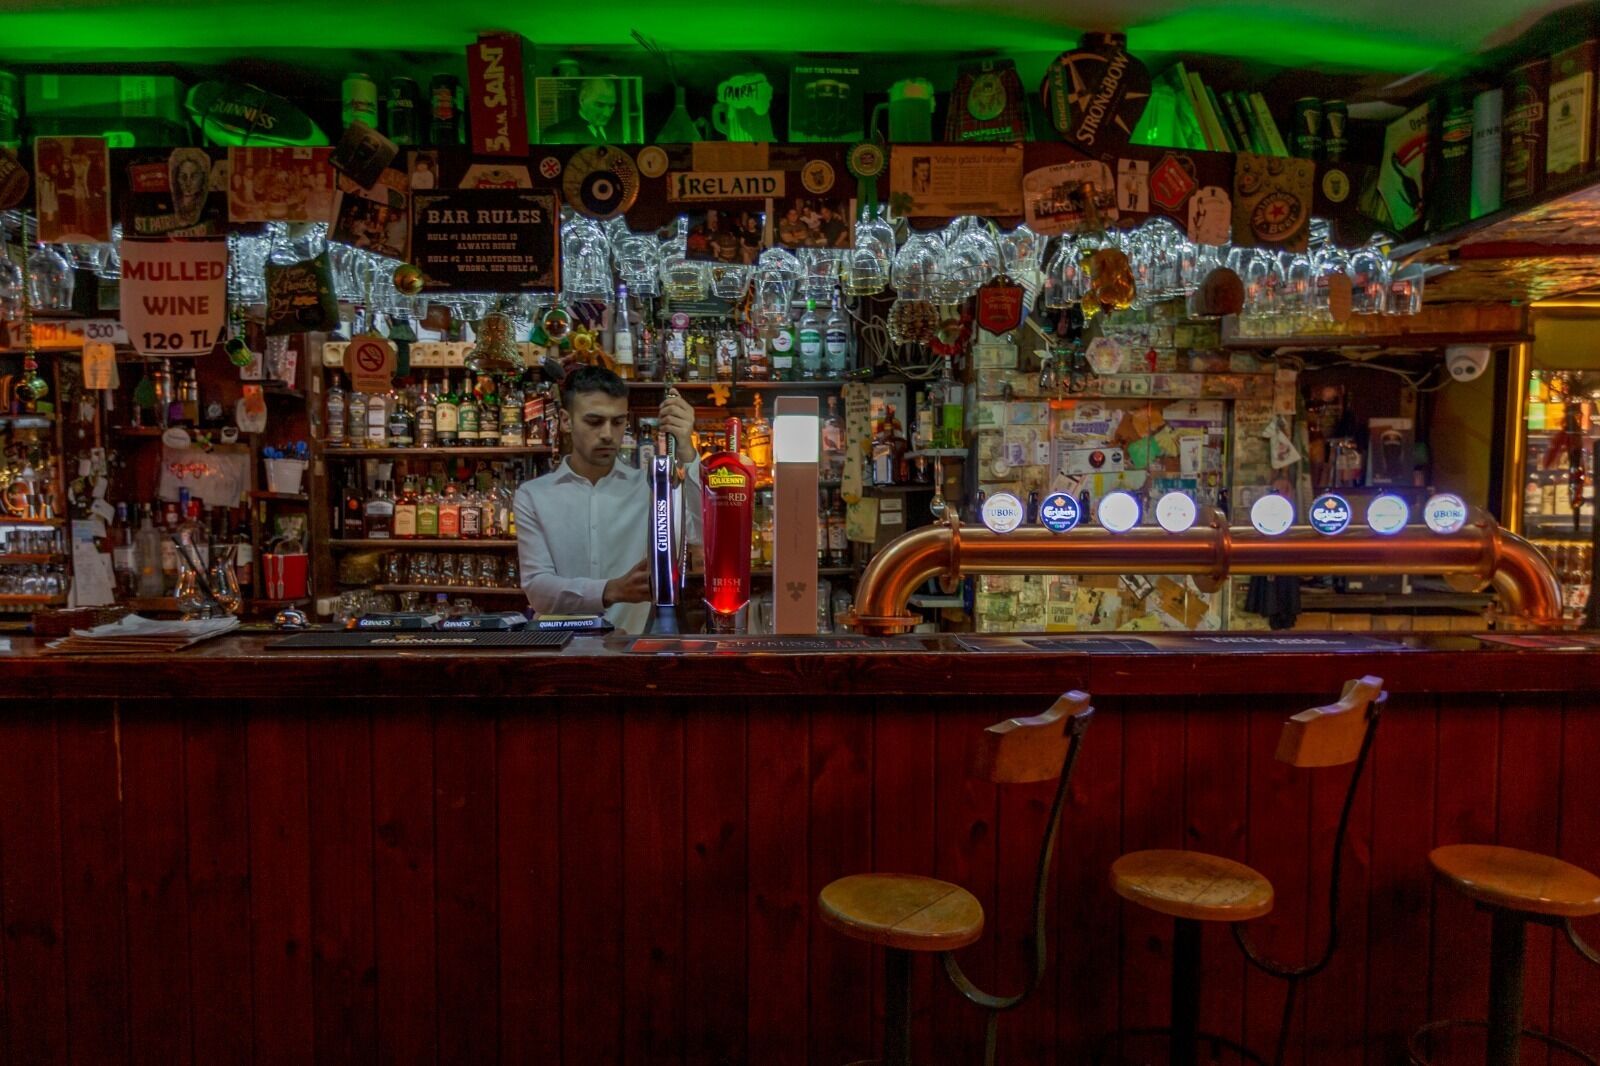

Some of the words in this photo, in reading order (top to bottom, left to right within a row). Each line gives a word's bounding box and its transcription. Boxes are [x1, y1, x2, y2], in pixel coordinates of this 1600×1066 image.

[480, 43, 508, 108] SAINT
[723, 80, 764, 101] MURAT
[1076, 49, 1129, 146] STRONGBOW
[677, 174, 777, 196] IRELAND
[1037, 194, 1115, 216] MAGNRS
[427, 209, 470, 224] BAR
[477, 209, 541, 224] RULES
[427, 233, 448, 241] RULE
[461, 233, 508, 241] BARTENDER
[457, 242, 490, 250] ALWAYS
[492, 242, 517, 250] RIGHT
[427, 255, 448, 263] RULE
[475, 255, 523, 263] BARTENDER
[123, 260, 224, 281] MULLED
[507, 264, 529, 272] RULE
[143, 296, 210, 316] WINE
[86, 323, 114, 339] 300
[143, 332, 184, 350] 120
[190, 329, 213, 349] TL
[710, 475, 744, 485] KILKENNY
[728, 492, 747, 502] RED
[657, 499, 668, 552] GUINNESS
[712, 577, 741, 586] IRISH
[563, 619, 594, 627] APPROVED
